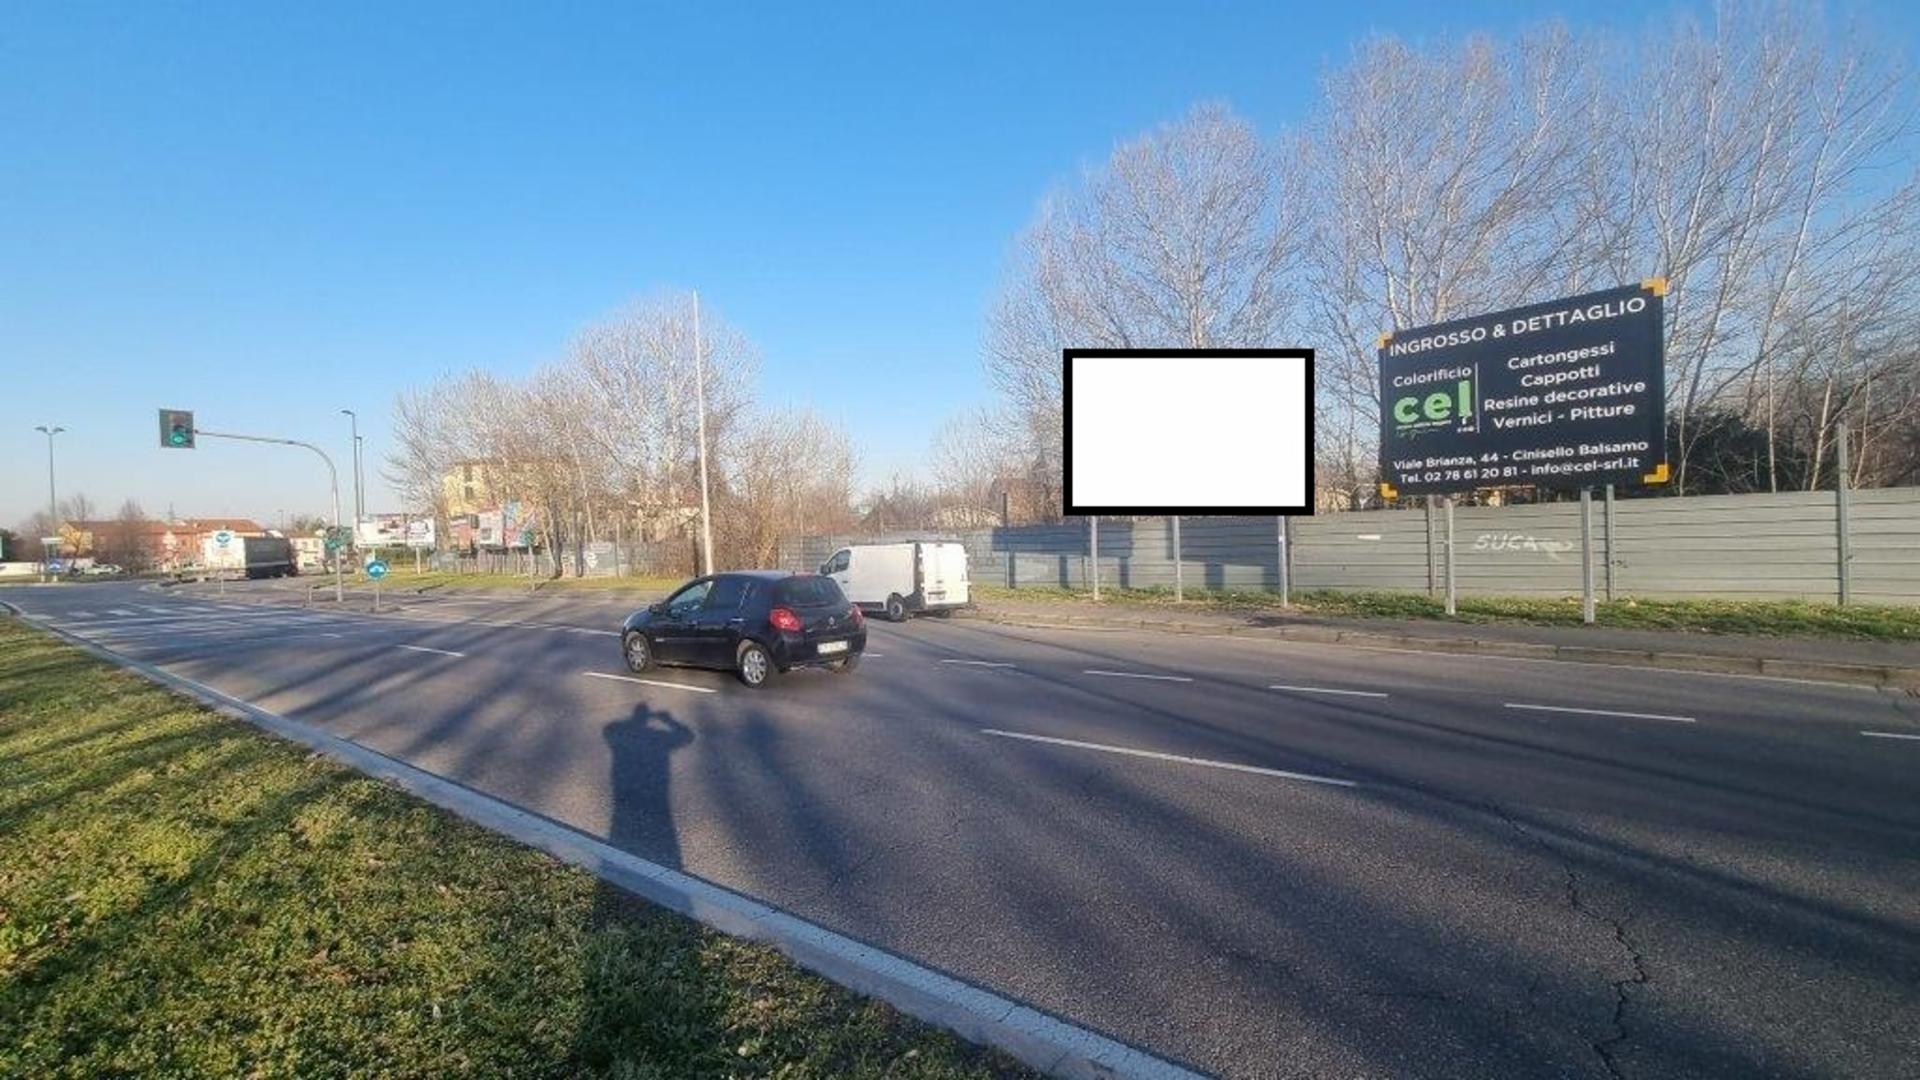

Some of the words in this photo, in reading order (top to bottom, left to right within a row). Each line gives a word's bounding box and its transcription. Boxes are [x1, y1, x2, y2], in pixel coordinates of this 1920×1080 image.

[1389, 327, 1486, 357] INGROSSO
[1492, 323, 1507, 340] &
[1512, 296, 1647, 334] DETTAGLIO
[1507, 341, 1615, 370] Cartongessi
[1393, 366, 1472, 388] Colorificio
[1521, 364, 1600, 389] Cappotti
[1484, 396, 1539, 412] Resine
[1544, 380, 1646, 404] decorative
[1493, 412, 1553, 430] Vernici
[1570, 403, 1636, 421] Pitture
[1393, 459, 1423, 471] Viale
[1426, 454, 1477, 468] Brianza,
[1480, 452, 1499, 463] 44
[1512, 446, 1575, 461] Cinisello
[1578, 440, 1649, 457] Balsamo
[1424, 472, 1442, 482] 02
[1445, 470, 1460, 481] 78
[1461, 469, 1478, 480] 61
[1480, 468, 1500, 479] 20
[1502, 466, 1518, 477] 81
[1531, 457, 1640, 477] info@cel-srl.it
